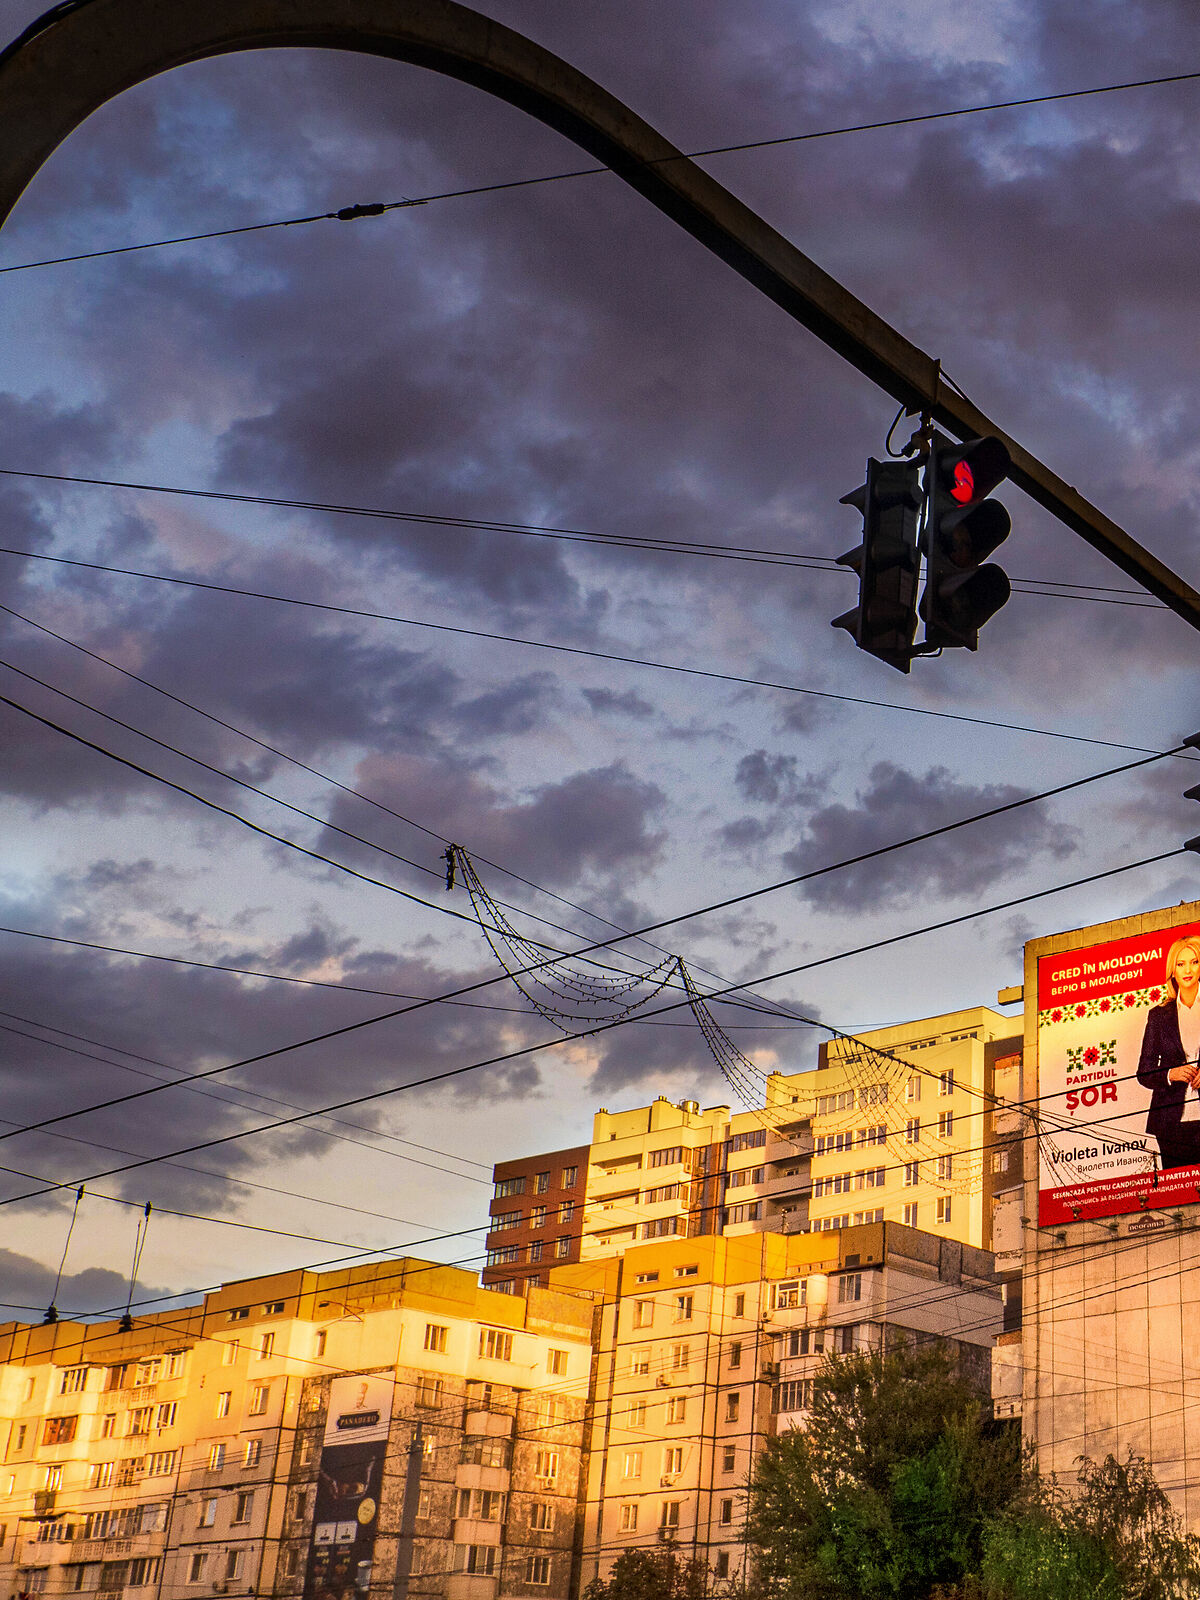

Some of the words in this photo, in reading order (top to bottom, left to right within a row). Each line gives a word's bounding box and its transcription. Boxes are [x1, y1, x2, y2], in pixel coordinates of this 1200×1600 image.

[1051, 967, 1081, 982] CRED
[1083, 962, 1096, 975] ÎN
[1098, 947, 1162, 972] MOLDOVA!
[1051, 983, 1078, 996] ВЕРЮ
[1080, 981, 1087, 989] В
[1089, 968, 1143, 988] МОЛДОВУ!
[1066, 1068, 1118, 1086] PARTIDUL
[1051, 1146, 1098, 1164] Violeta
[1102, 1138, 1148, 1156] Ivanov
[1077, 1160, 1115, 1173] Виолетта
[1086, 1184, 1111, 1195] PENTRU
[1165, 1171, 1191, 1182] PARTEA
